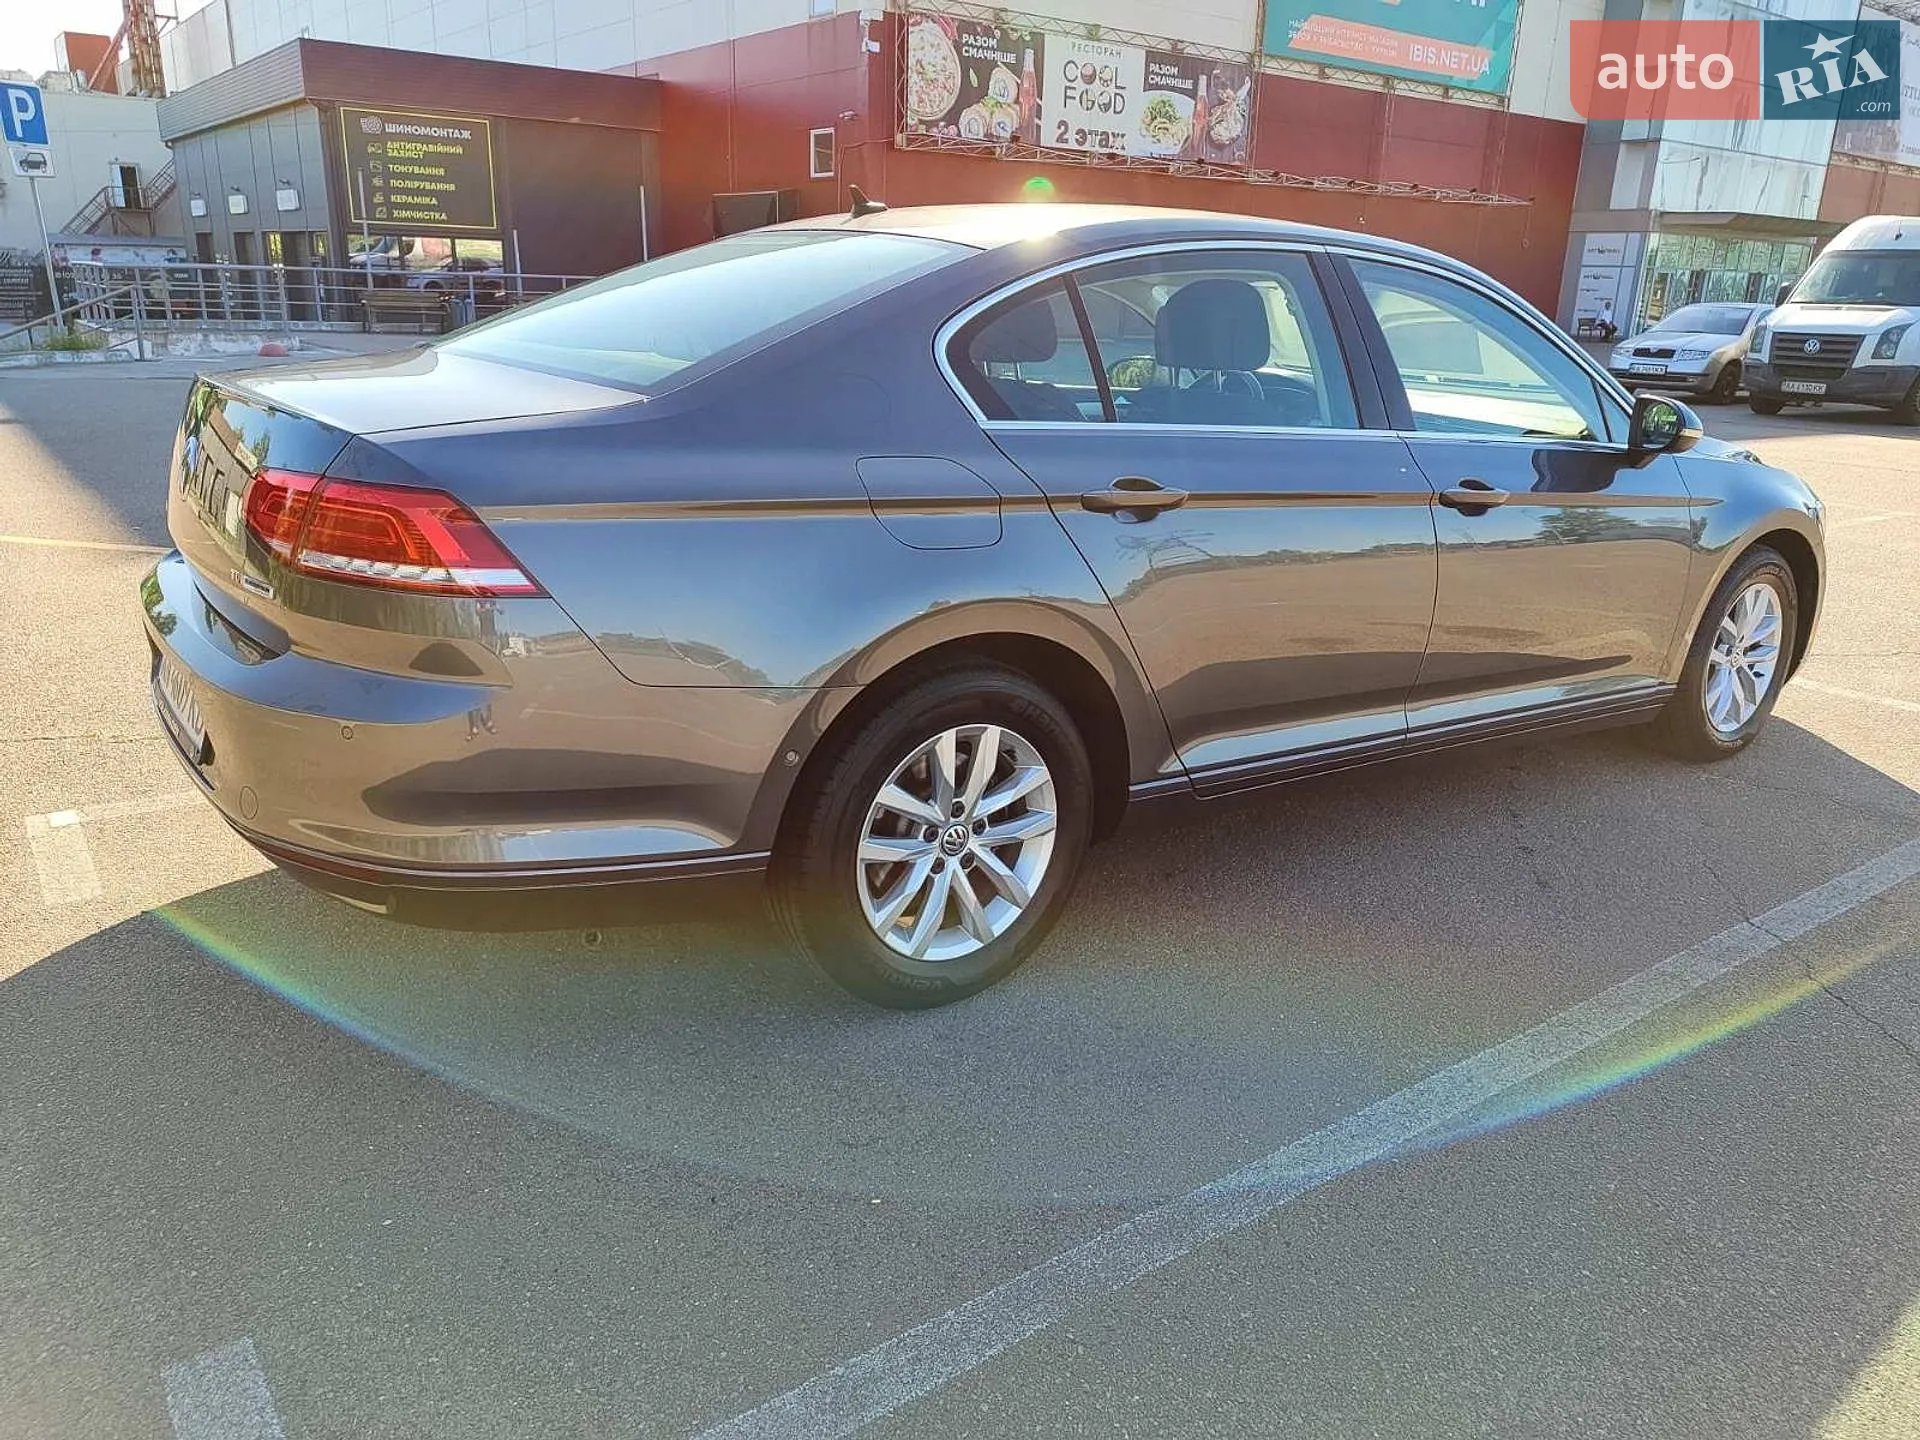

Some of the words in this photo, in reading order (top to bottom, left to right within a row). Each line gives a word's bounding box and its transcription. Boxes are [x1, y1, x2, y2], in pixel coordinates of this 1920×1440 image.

[962, 33, 998, 50] РАЗОМ
[962, 47, 1018, 65] СМАЧНІШЕ
[1071, 42, 1122, 59] РЕСТОРАН
[1409, 43, 1490, 74] IBIS.NET.UA
[1063, 59, 1127, 90] COOL
[1149, 63, 1180, 77] РАЗОМ
[1148, 74, 1195, 91] СМАЧНІШЕ
[1063, 86, 1126, 116] FOOD
[8, 88, 36, 137] P
[384, 122, 472, 140] ШИНОМОНТАЖ
[1056, 120, 1070, 144] 2
[1074, 129, 1127, 151] этаж
[386, 141, 464, 155] АНТИГРАВІЙНИЙ
[386, 149, 425, 160] ЗАХИСТ
[387, 164, 445, 177] ТОНУВАННЯ
[390, 180, 456, 191] ПОЛІРУВАННЯ
[391, 194, 438, 205] КЕРАМІКА
[393, 210, 448, 221] ХІМЧИСТКА
